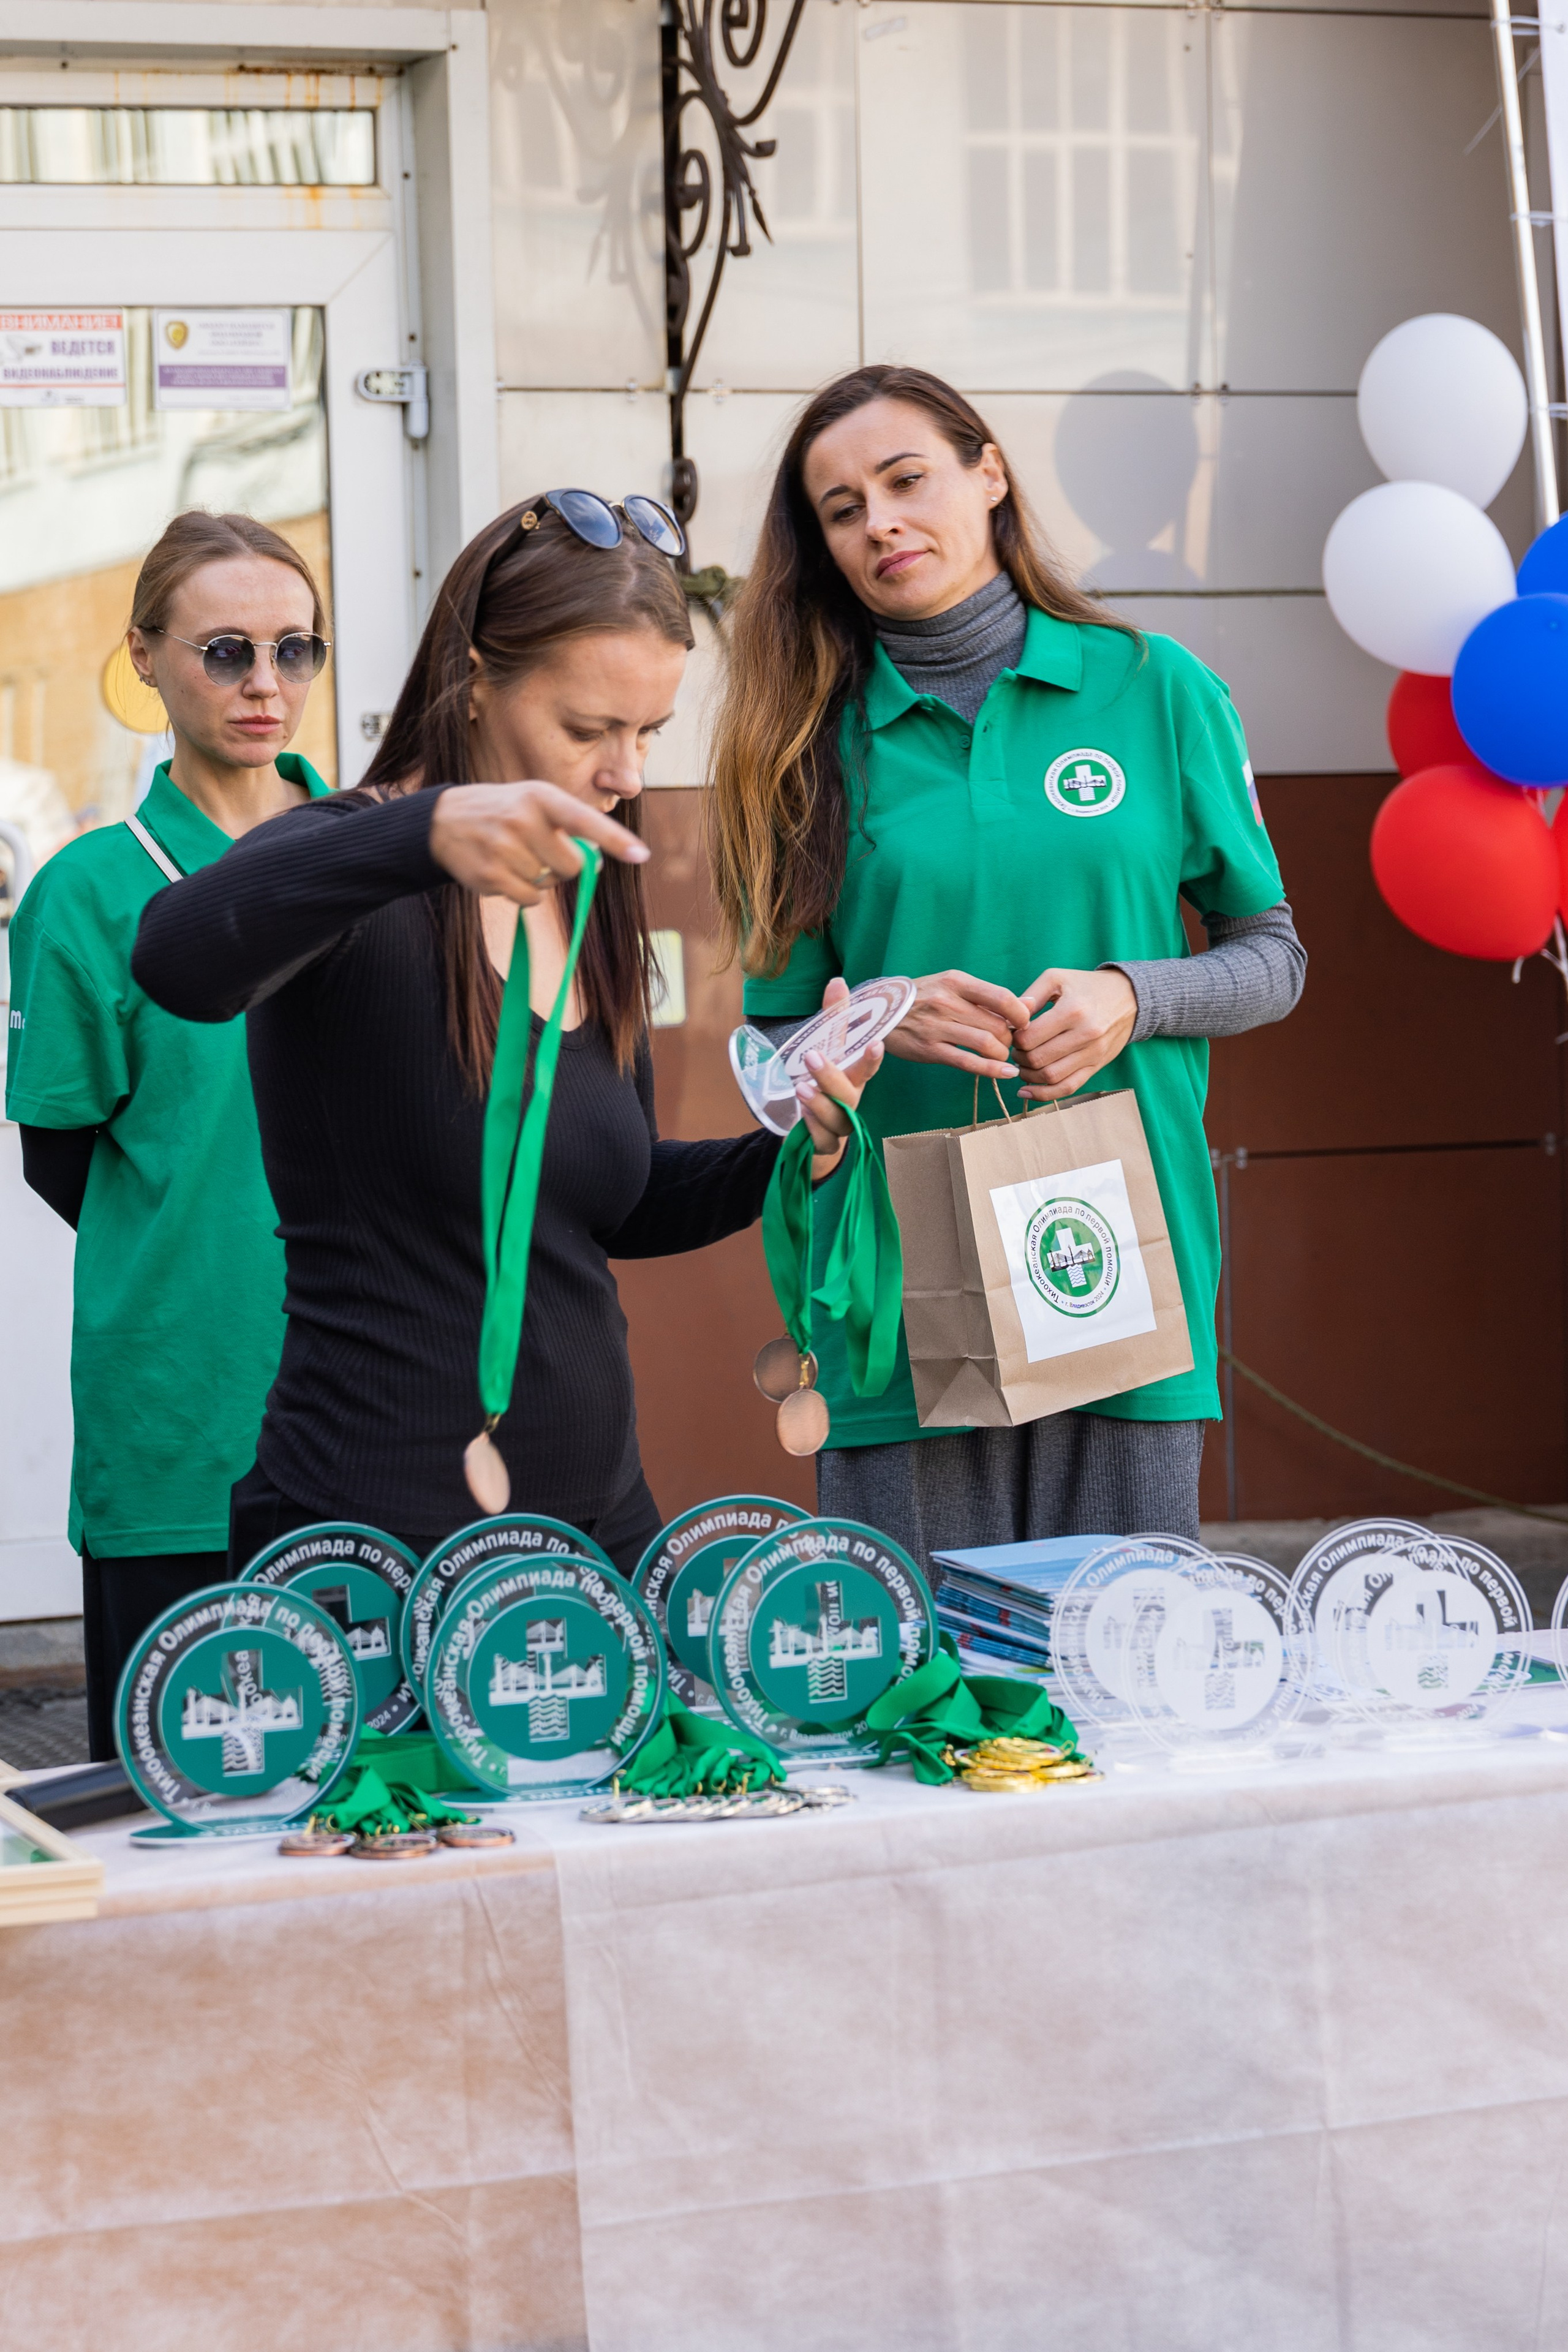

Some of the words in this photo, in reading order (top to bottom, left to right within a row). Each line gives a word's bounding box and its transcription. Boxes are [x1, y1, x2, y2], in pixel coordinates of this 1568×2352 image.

[51, 341, 115, 355] ВЕДЕТСЯ
[4, 368, 118, 380] ВИДЕОНАБЛЮДЕНИЕ
[1033, 1206, 1072, 1233] Олимпиада
[1075, 1208, 1085, 1216] по
[1086, 1213, 1111, 1244] первой
[1030, 1234, 1060, 1303] Тихоокеанская
[1104, 1246, 1114, 1286] помощи
[1094, 1291, 1104, 1302] 2024
[439, 1530, 543, 1577] Олимпиада
[546, 1537, 570, 1555] по
[666, 1511, 771, 1556] Олимпиада
[1318, 1533, 1404, 1572] Олимпиада
[252, 1539, 355, 1584] Олимпиада
[358, 1544, 382, 1563] по
[853, 1541, 876, 1562] по
[876, 1556, 922, 1622] первой
[1086, 1549, 1174, 1587] Олимпиада
[466, 1570, 576, 1618] Олимпиада
[1461, 1556, 1480, 1575] по
[1478, 1571, 1518, 1628] первой
[605, 1591, 647, 1661] первой
[132, 1649, 181, 1804] Тихоокеанская
[275, 1605, 301, 1629] по
[610, 1665, 649, 1747] помощи
